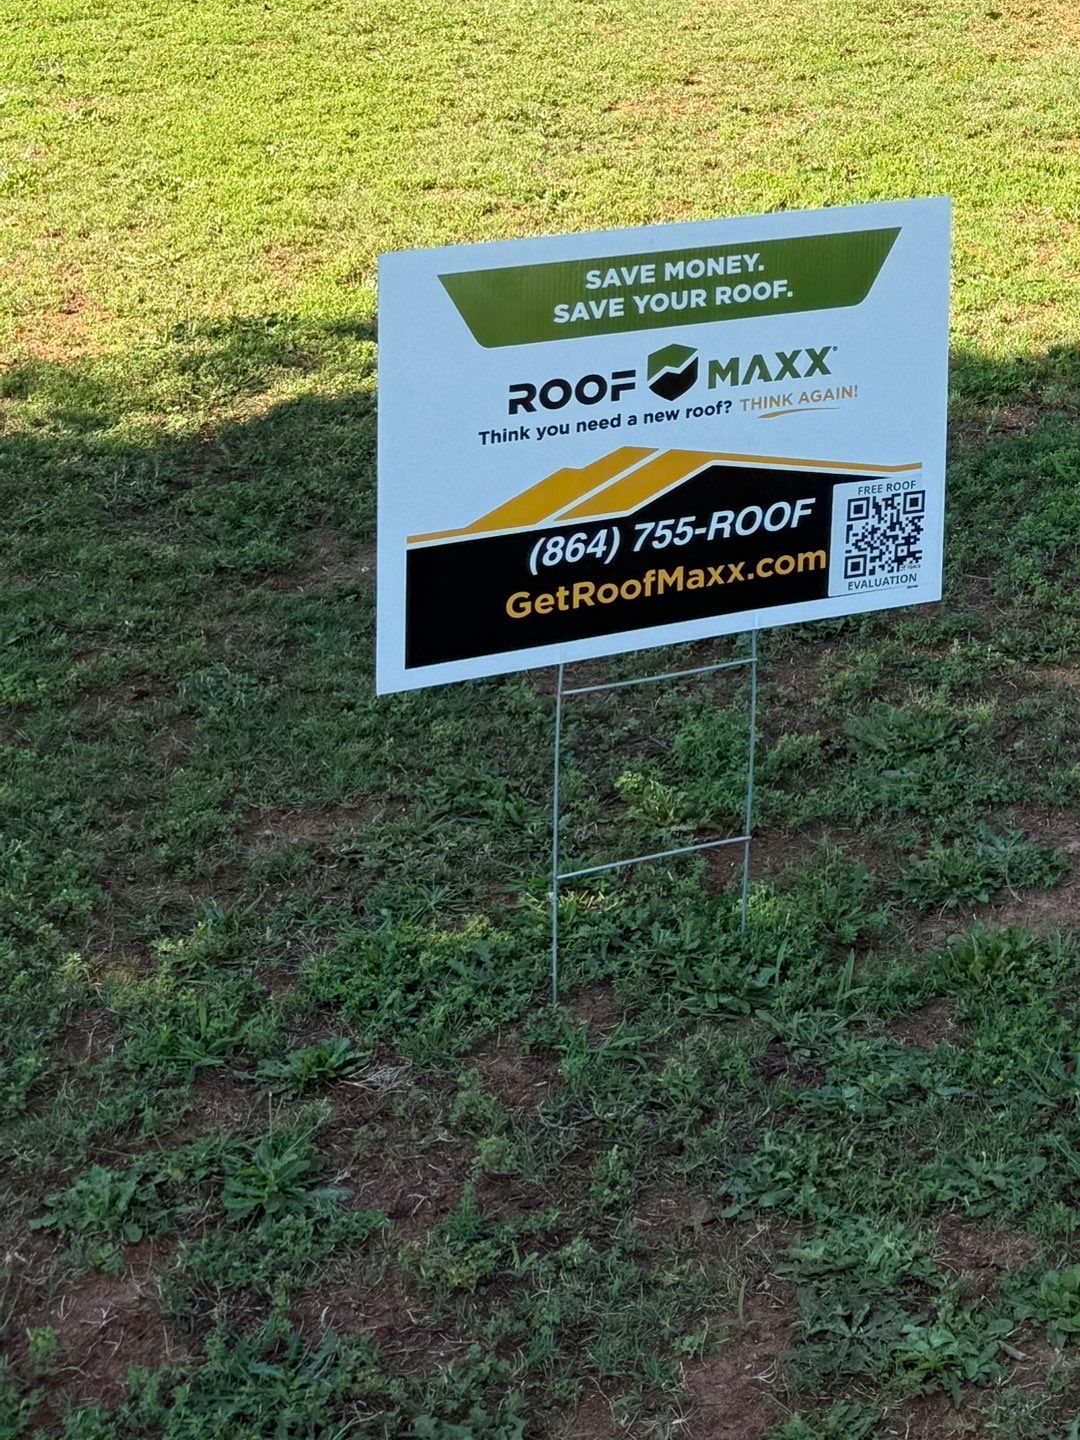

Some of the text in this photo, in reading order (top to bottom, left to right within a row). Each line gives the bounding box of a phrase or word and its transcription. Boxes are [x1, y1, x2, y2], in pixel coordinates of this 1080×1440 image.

[586, 253, 764, 289] SAVE MONEY.
[553, 279, 793, 324] SAVE YOUR ROOF.
[508, 369, 636, 415] ROOF
[478, 385, 859, 446] Think you need a new roof? THINK AGAIN!
[857, 480, 916, 495] FREE ROOF
[528, 497, 816, 576] (864) 755-ROOF
[505, 549, 827, 619] GetRoofMaxx.com
[847, 573, 917, 591] EVALUATION
